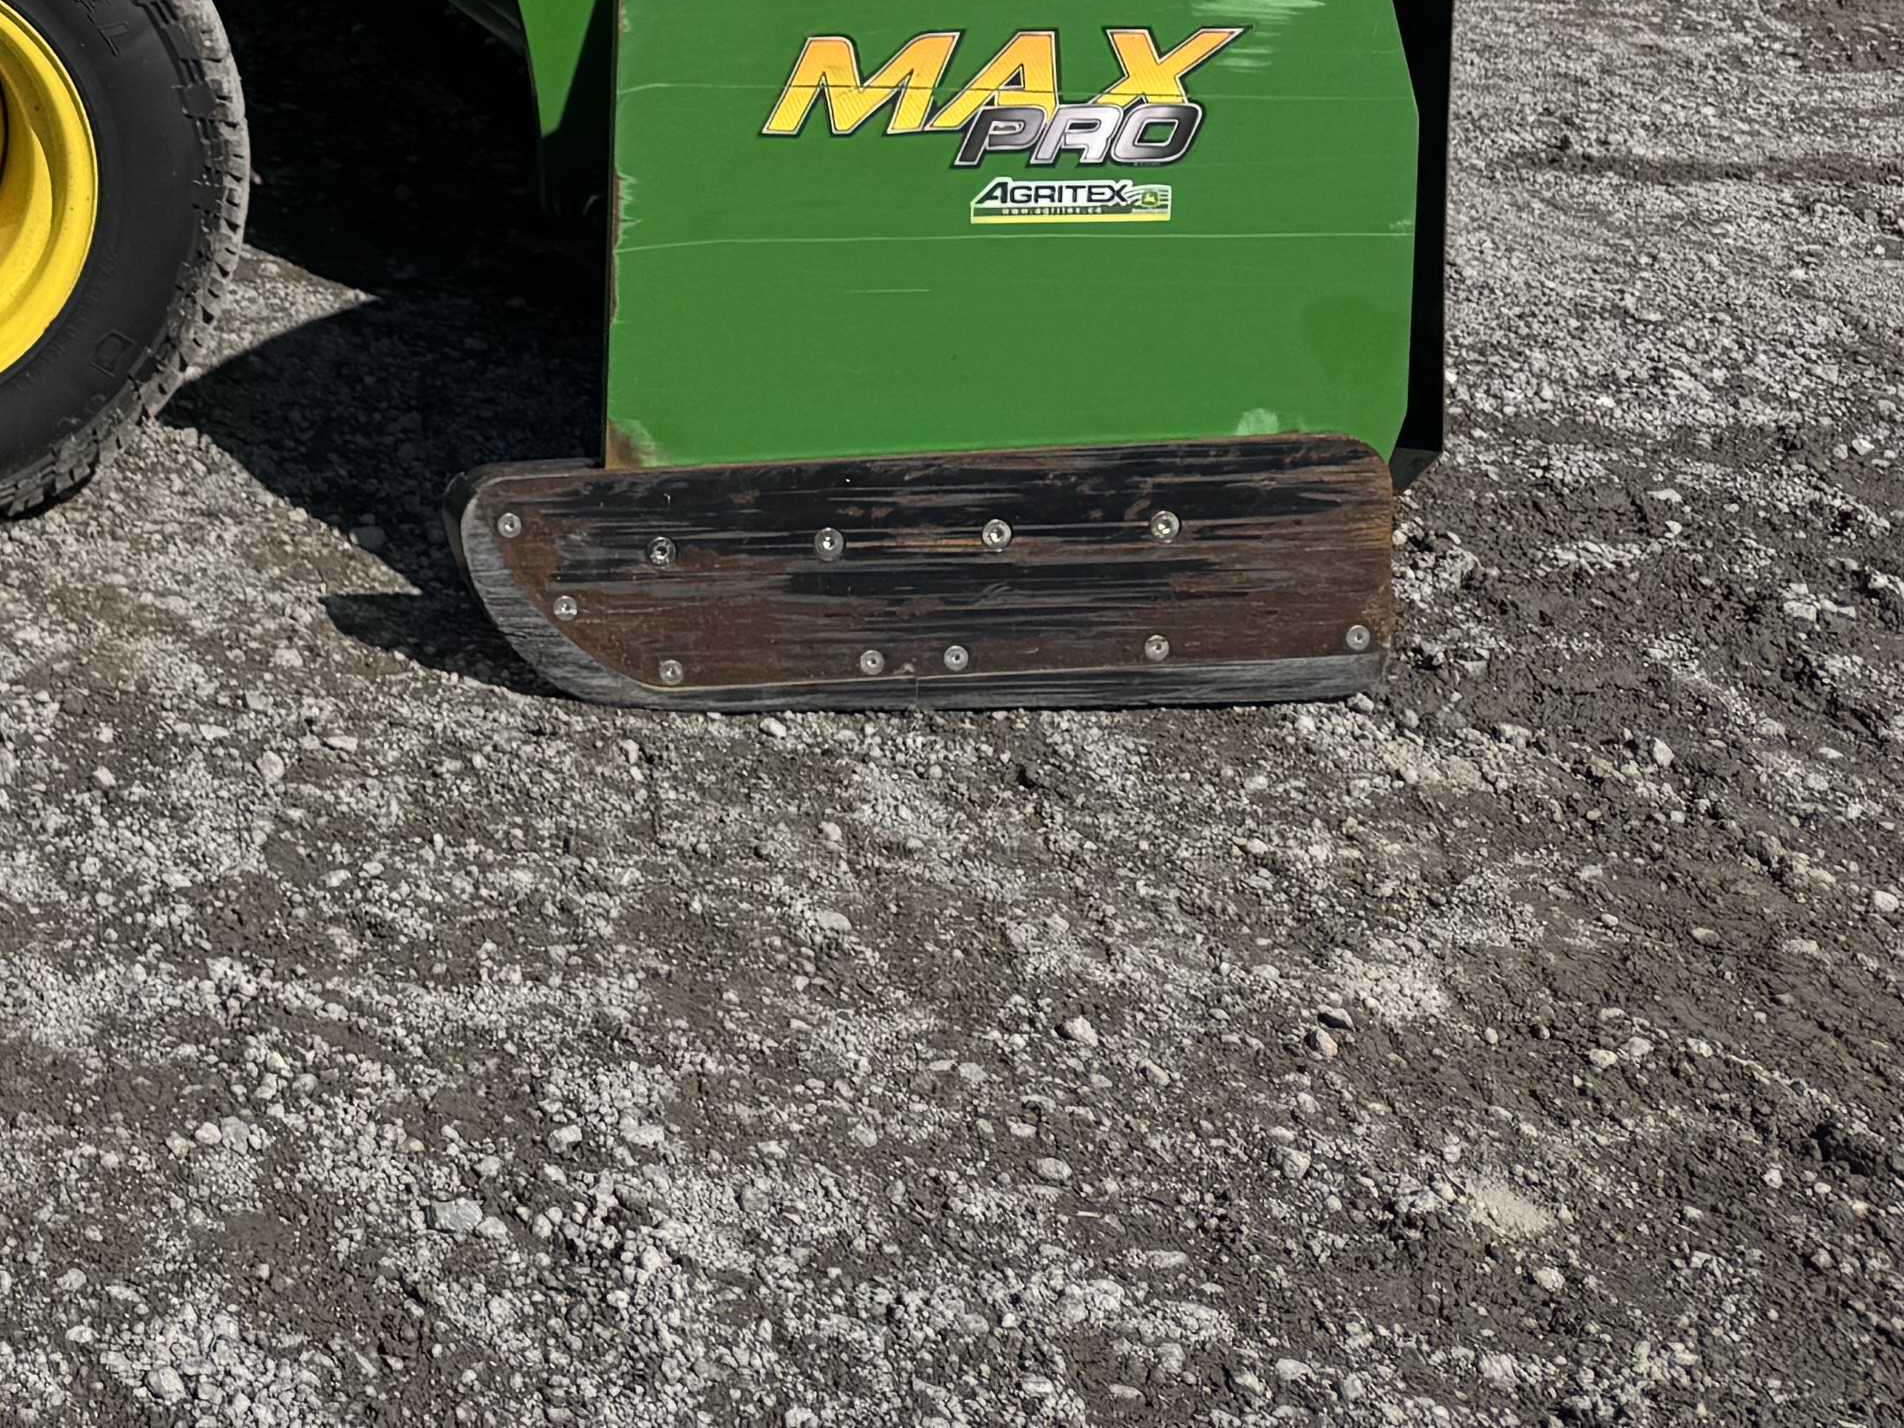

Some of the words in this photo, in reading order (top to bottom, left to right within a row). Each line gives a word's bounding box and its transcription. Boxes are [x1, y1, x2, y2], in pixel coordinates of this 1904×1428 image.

[762, 24, 1255, 137] MAX
[949, 102, 1204, 168] PRO
[975, 180, 1129, 205] AGRITEX
